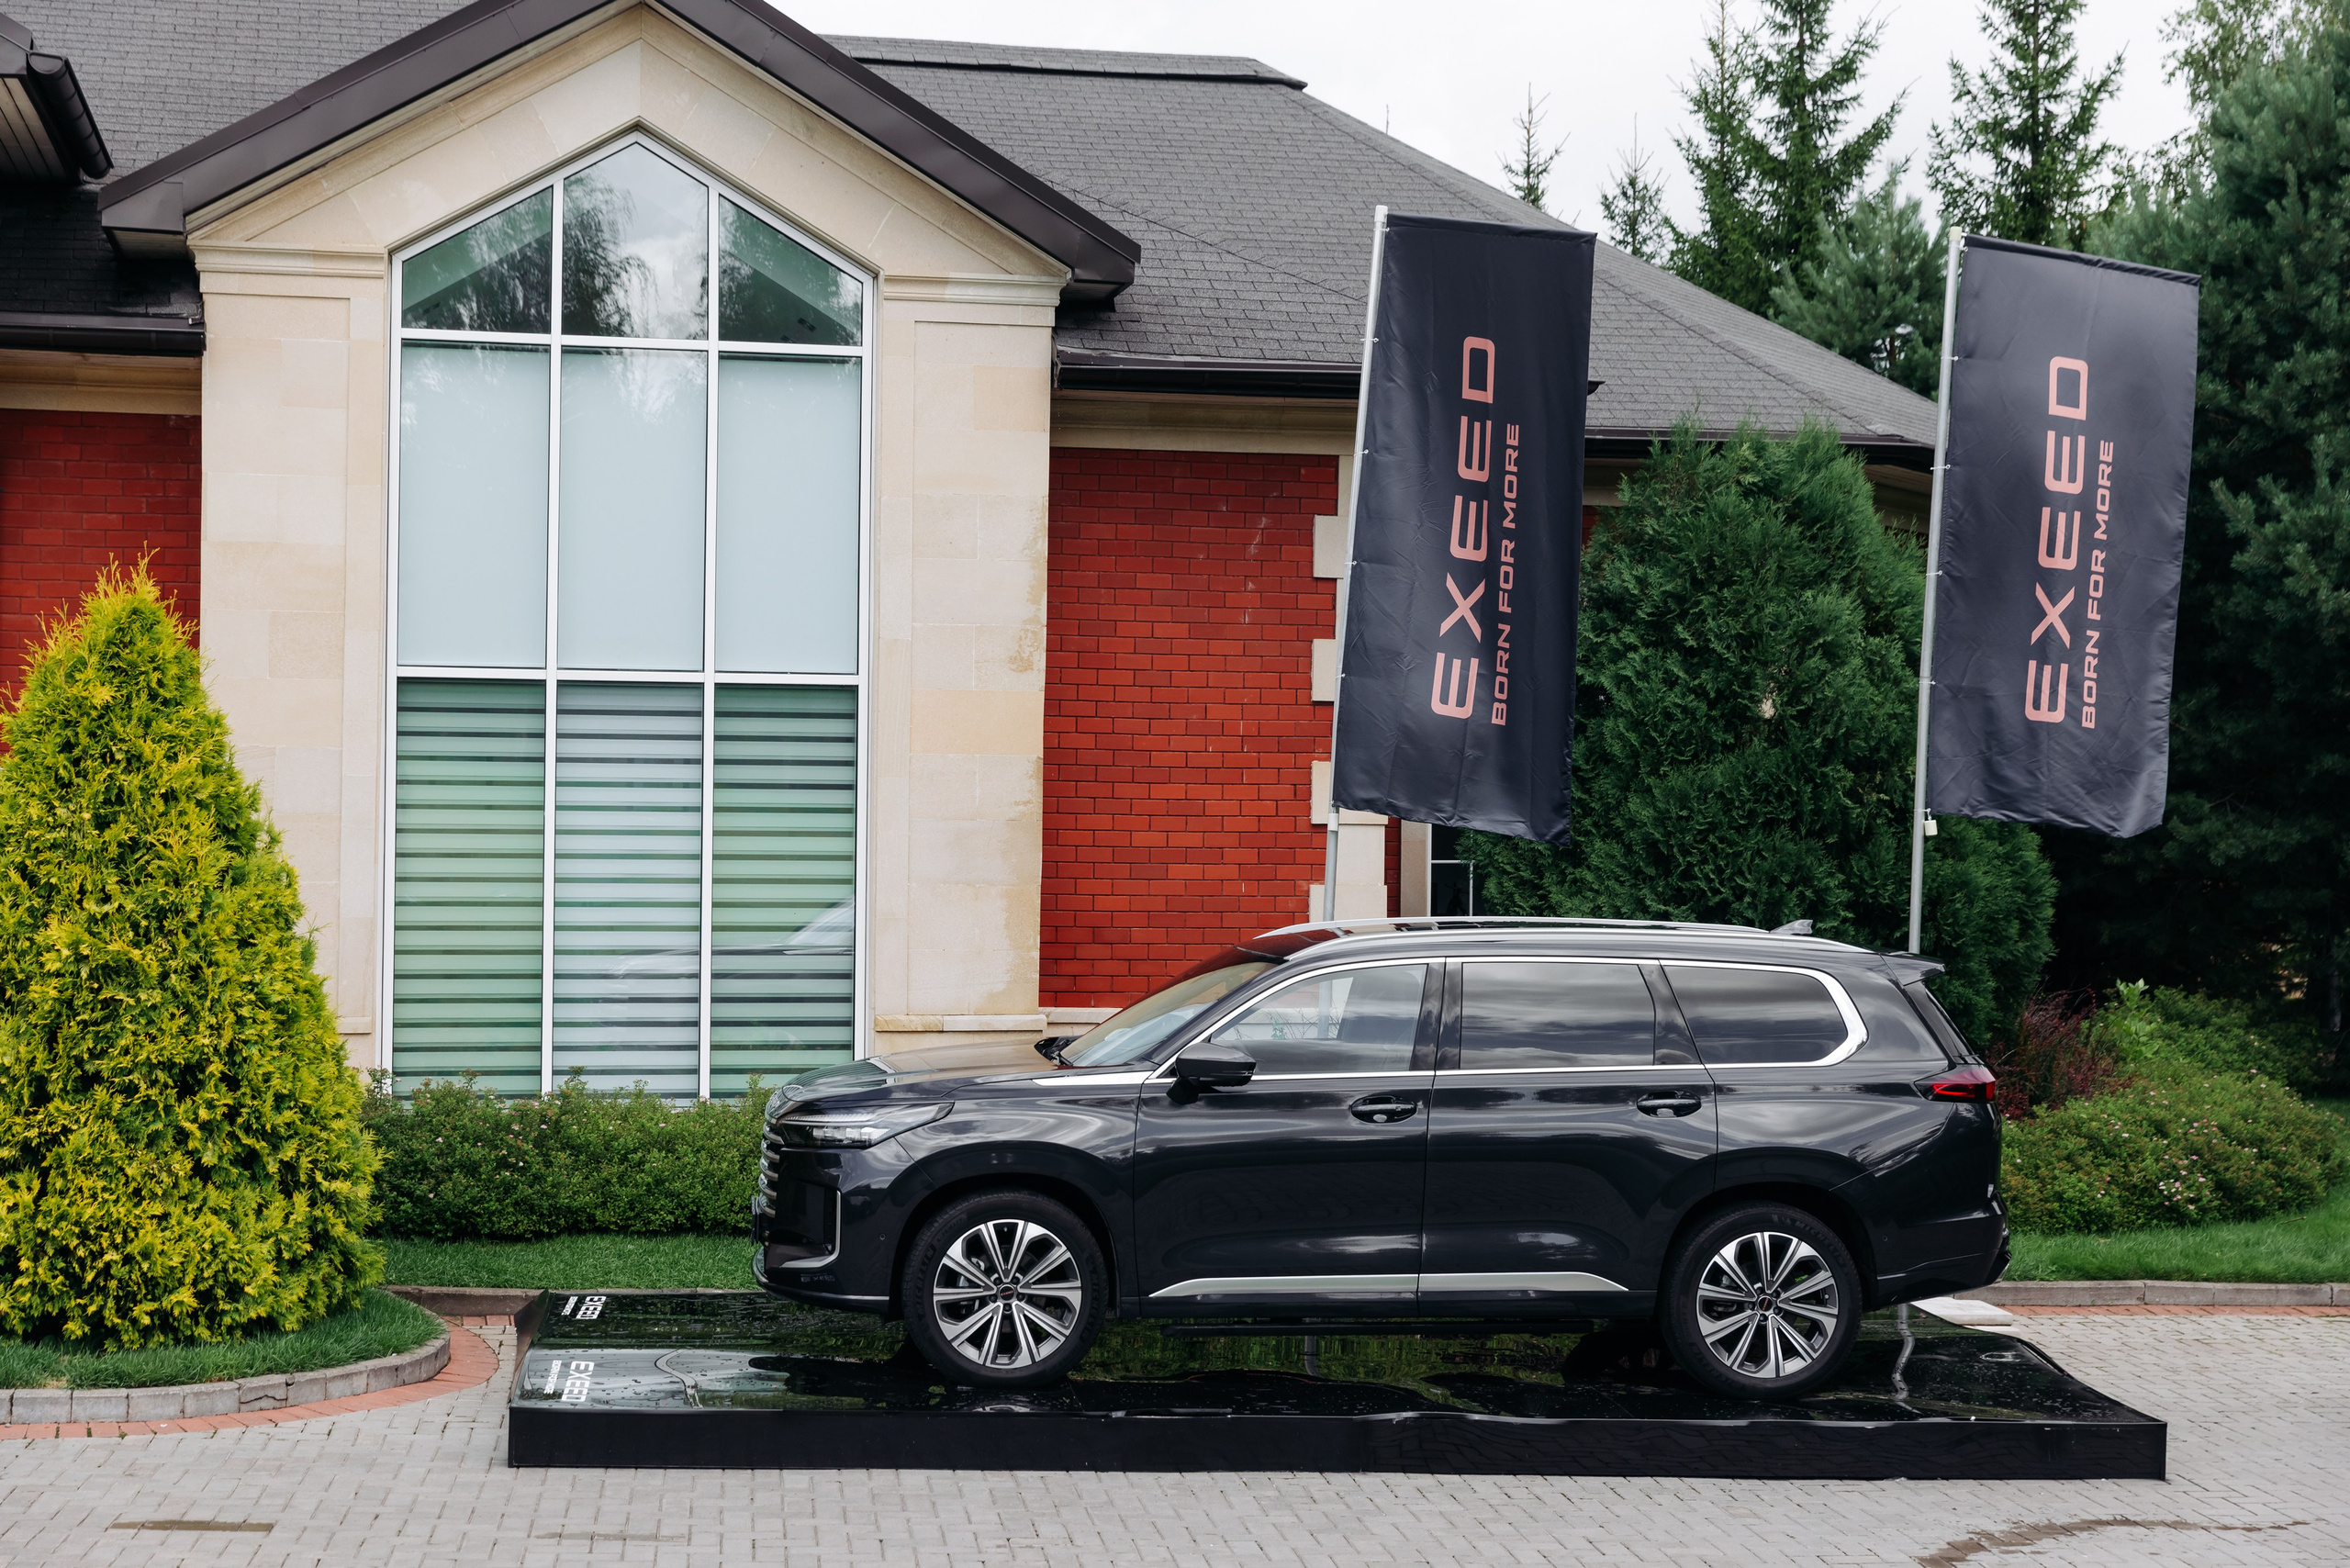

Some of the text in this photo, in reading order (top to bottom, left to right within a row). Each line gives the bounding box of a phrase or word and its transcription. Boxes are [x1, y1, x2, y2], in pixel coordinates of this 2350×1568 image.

[1431, 336, 1495, 719] EXEED
[1492, 423, 1519, 726] BORN FOR MORE
[2025, 356, 2088, 723] EXEED
[2082, 441, 2114, 729] BORN FOR MORE
[561, 1361, 595, 1402] EXEED
[576, 1295, 607, 1319] EXEED
